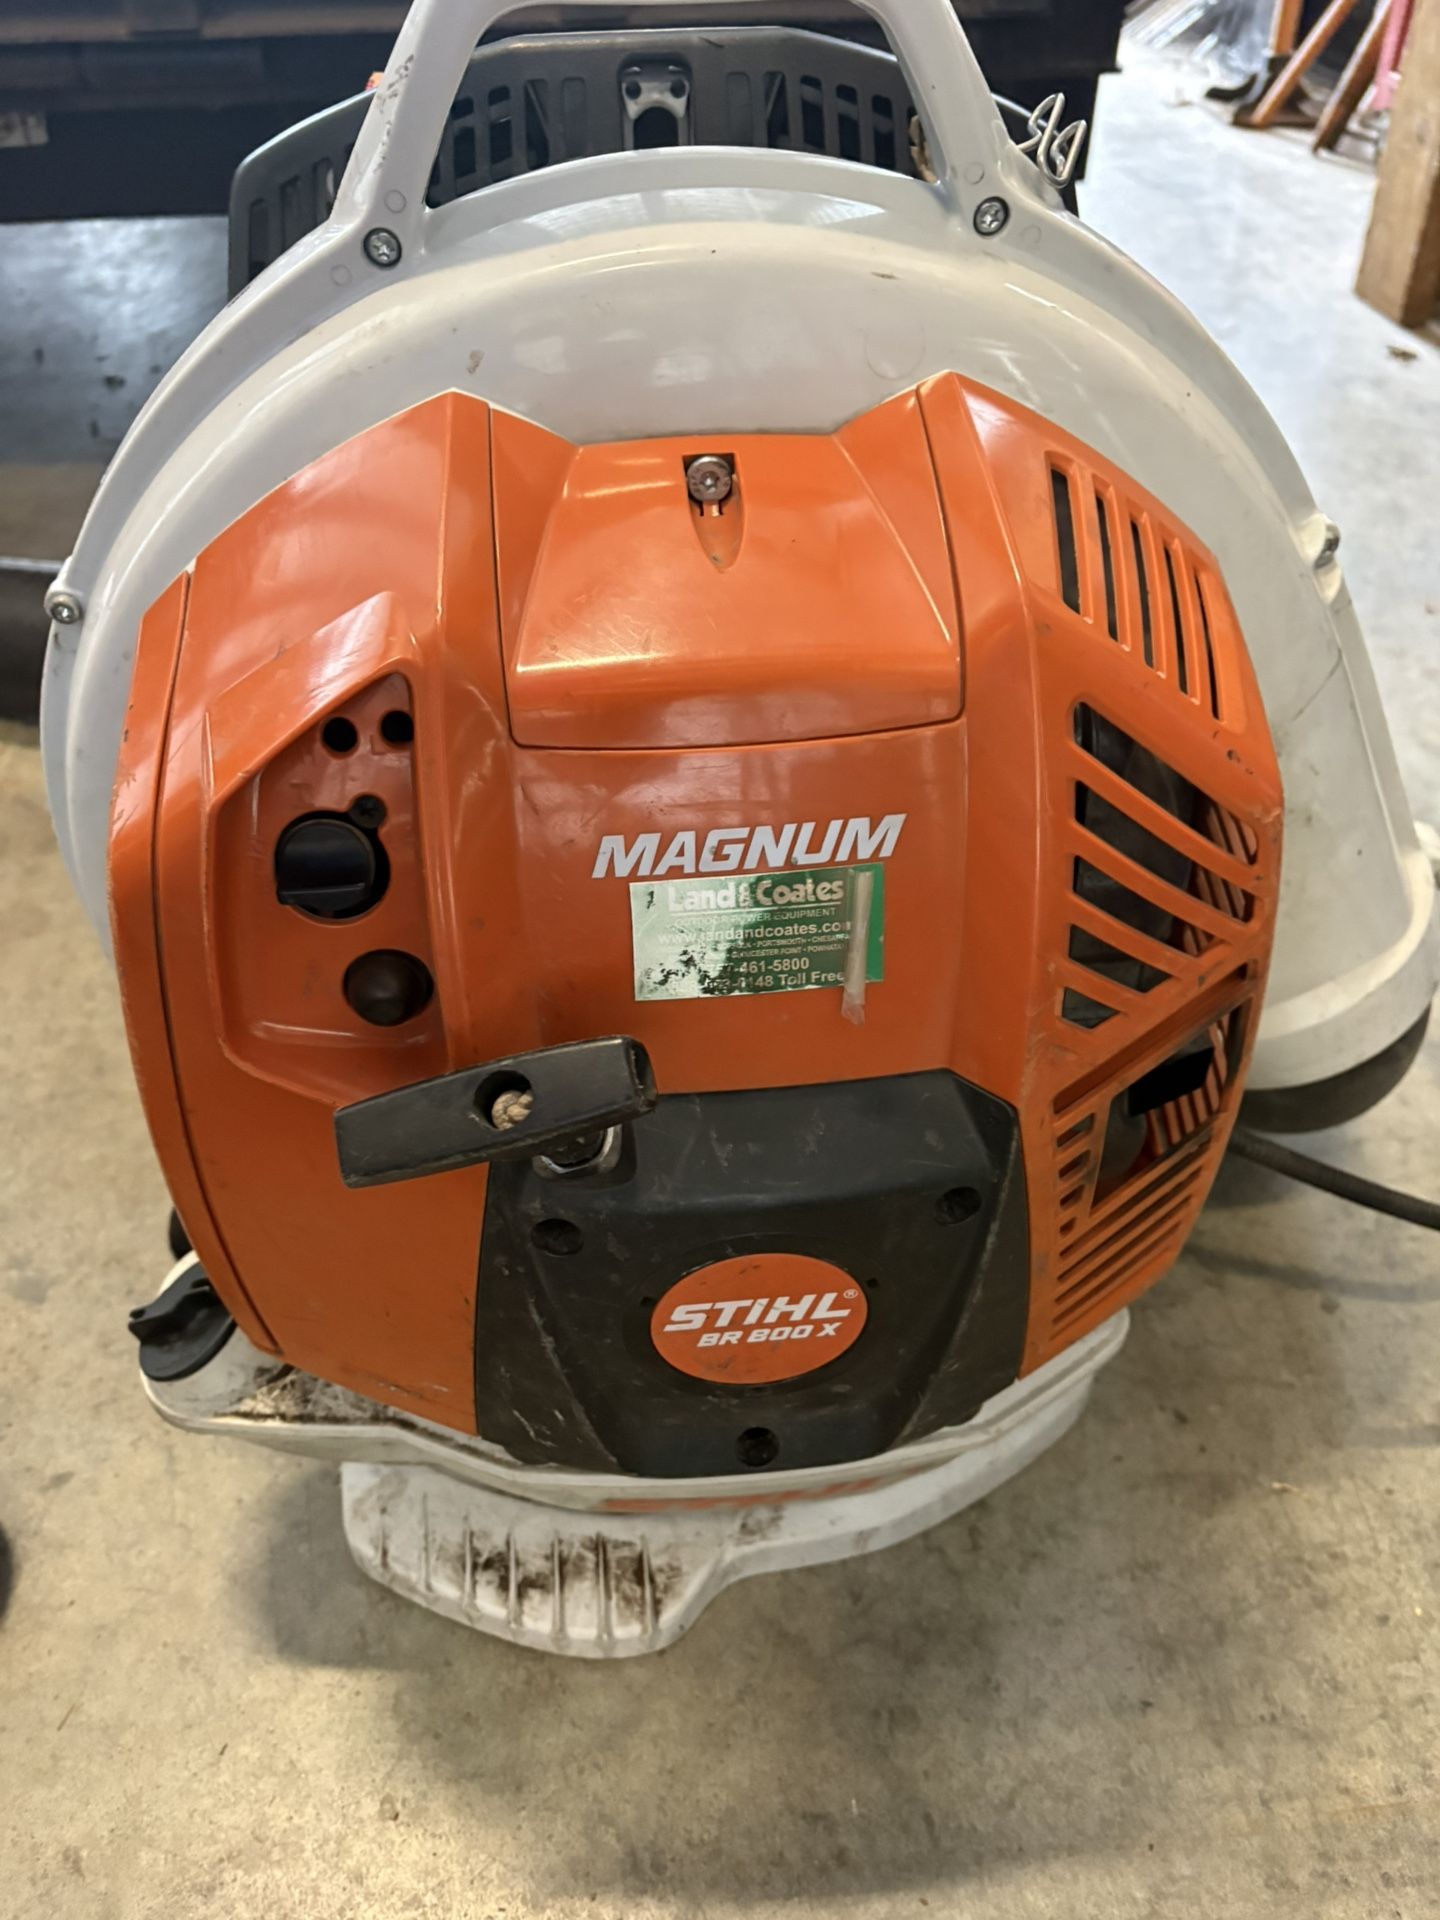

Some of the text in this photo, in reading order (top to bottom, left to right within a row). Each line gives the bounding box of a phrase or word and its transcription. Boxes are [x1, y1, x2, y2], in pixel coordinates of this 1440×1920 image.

[592, 813, 907, 879] MAGNUM
[667, 881, 737, 912] Land
[756, 878, 845, 906] Coates
[774, 907, 837, 920] EQUIPMENT
[778, 972, 806, 986] Toll
[697, 1321, 843, 1348] BR 800 X
